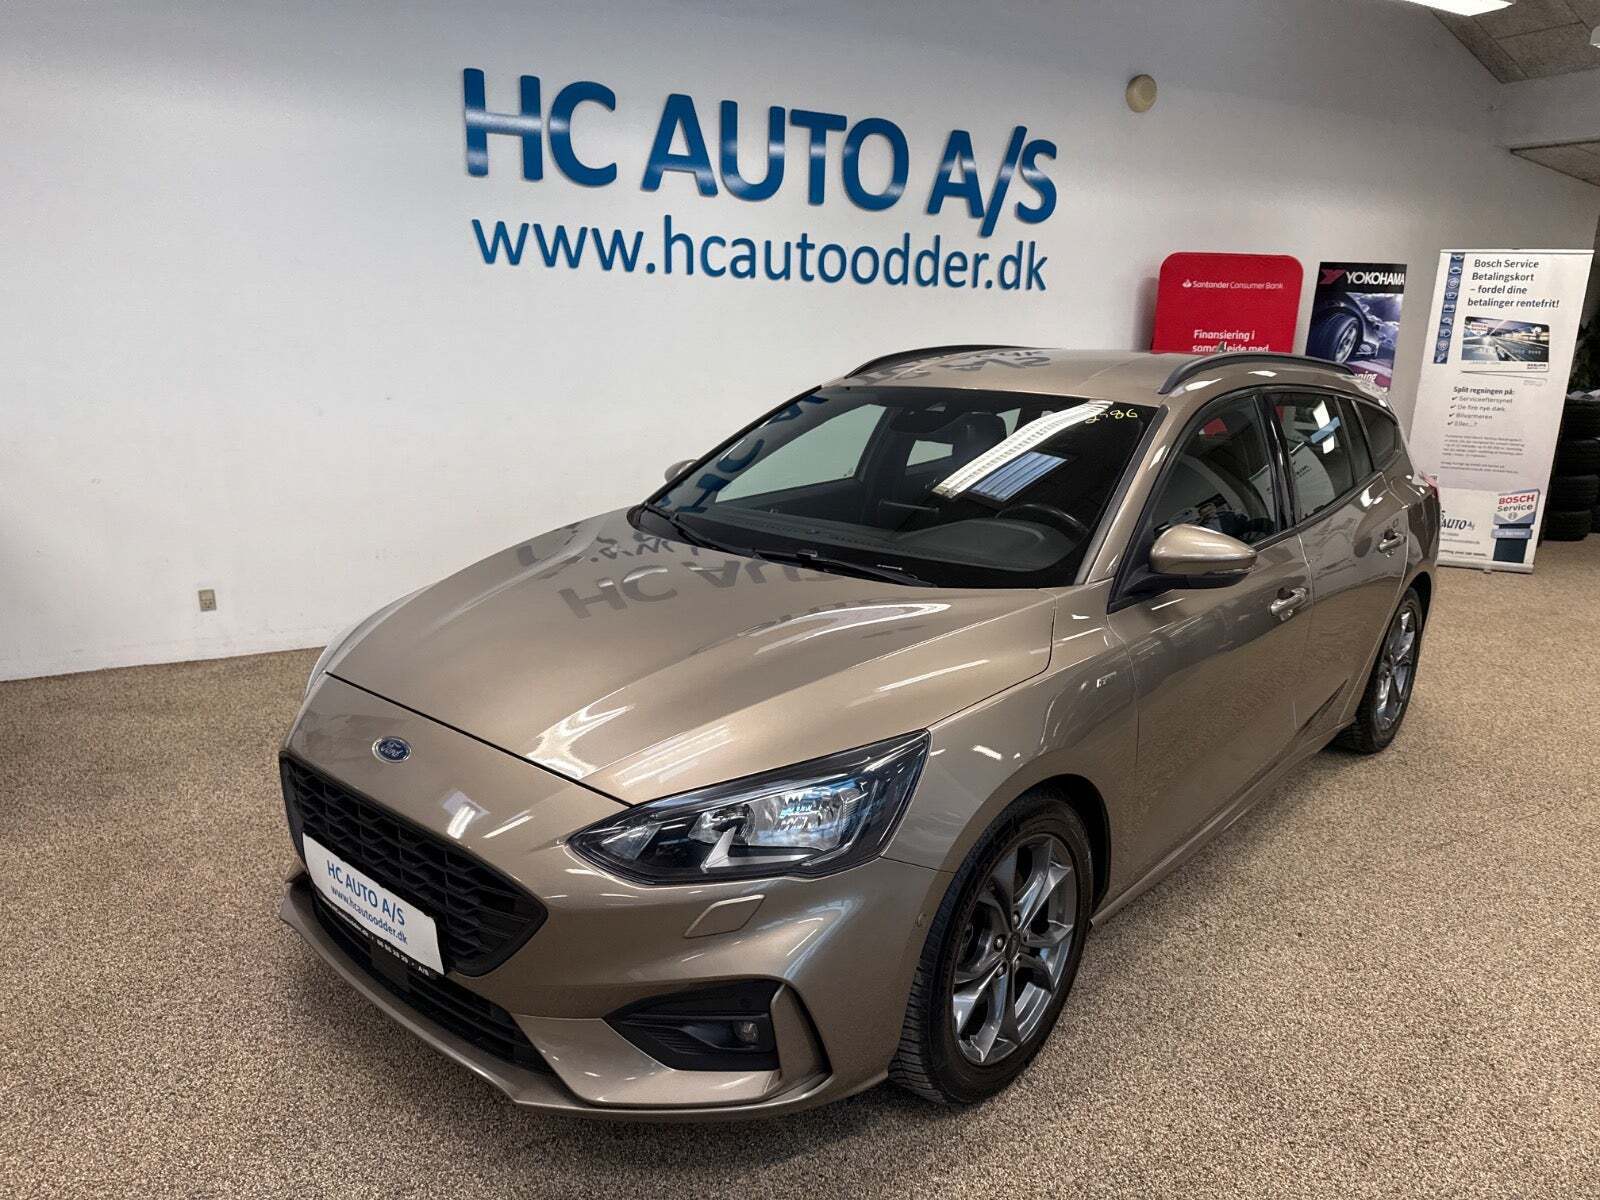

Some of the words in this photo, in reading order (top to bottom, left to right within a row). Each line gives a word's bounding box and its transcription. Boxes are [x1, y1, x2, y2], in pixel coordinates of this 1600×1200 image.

[463, 67, 617, 187] HC
[641, 93, 909, 211] AUTO
[927, 125, 1057, 238] A/S
[471, 214, 1048, 291] www.hcautoodder.dk
[1474, 259, 1502, 268] Bosch
[1504, 259, 1540, 268] Service
[1346, 271, 1405, 286] YOKOHAMA
[1472, 272, 1534, 282] Betalingskort
[1193, 280, 1229, 289] Santander
[1230, 281, 1265, 290] Consumer
[1265, 282, 1284, 290] Bank
[1477, 286, 1506, 294] fordel
[1506, 286, 1528, 294] dine
[1467, 298, 1514, 308] betalinger
[1515, 299, 1560, 308] rentefrit!
[1193, 329, 1250, 342] Finansiering
[1453, 386, 1469, 394] Split
[1470, 387, 1503, 395] regningen
[1498, 494, 1536, 505] BOSCH
[1497, 504, 1534, 513] Service
[326, 859, 343, 884] HC
[345, 873, 378, 908] AUTO
[382, 898, 405, 926] A/S
[330, 884, 408, 945] www.hcautoodder.dk
